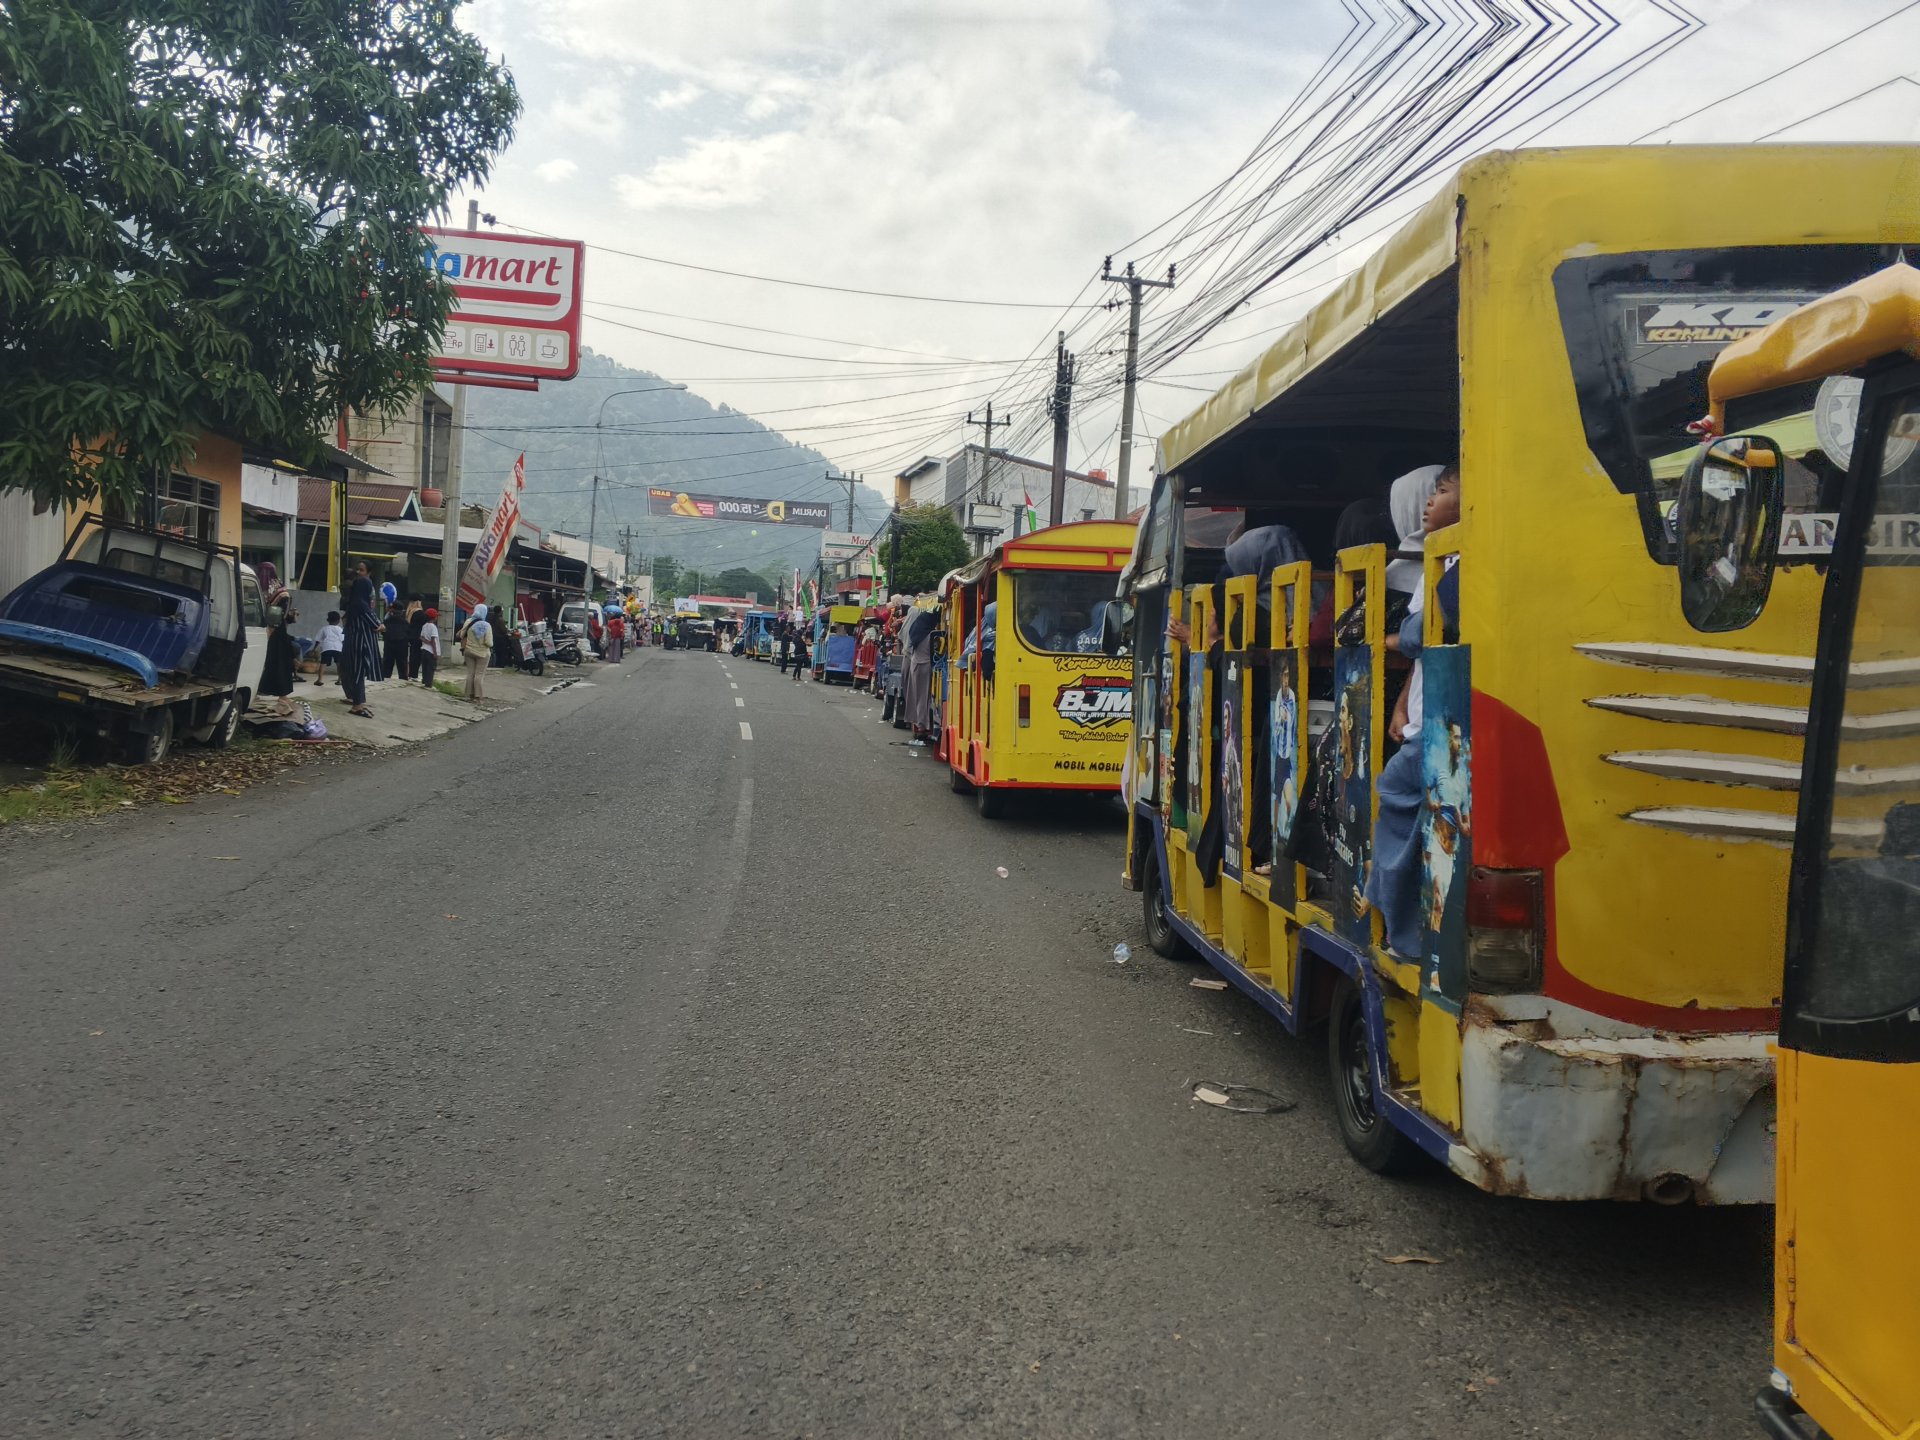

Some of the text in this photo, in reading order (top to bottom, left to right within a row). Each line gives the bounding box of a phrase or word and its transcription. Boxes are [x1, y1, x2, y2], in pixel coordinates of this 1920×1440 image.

[475, 490, 516, 570] Alfamart
[851, 535, 869, 545] Mar
[1054, 656, 1132, 671] Kereta Wis
[1058, 690, 1132, 711] BJM
[1054, 761, 1086, 770] MOBIL
